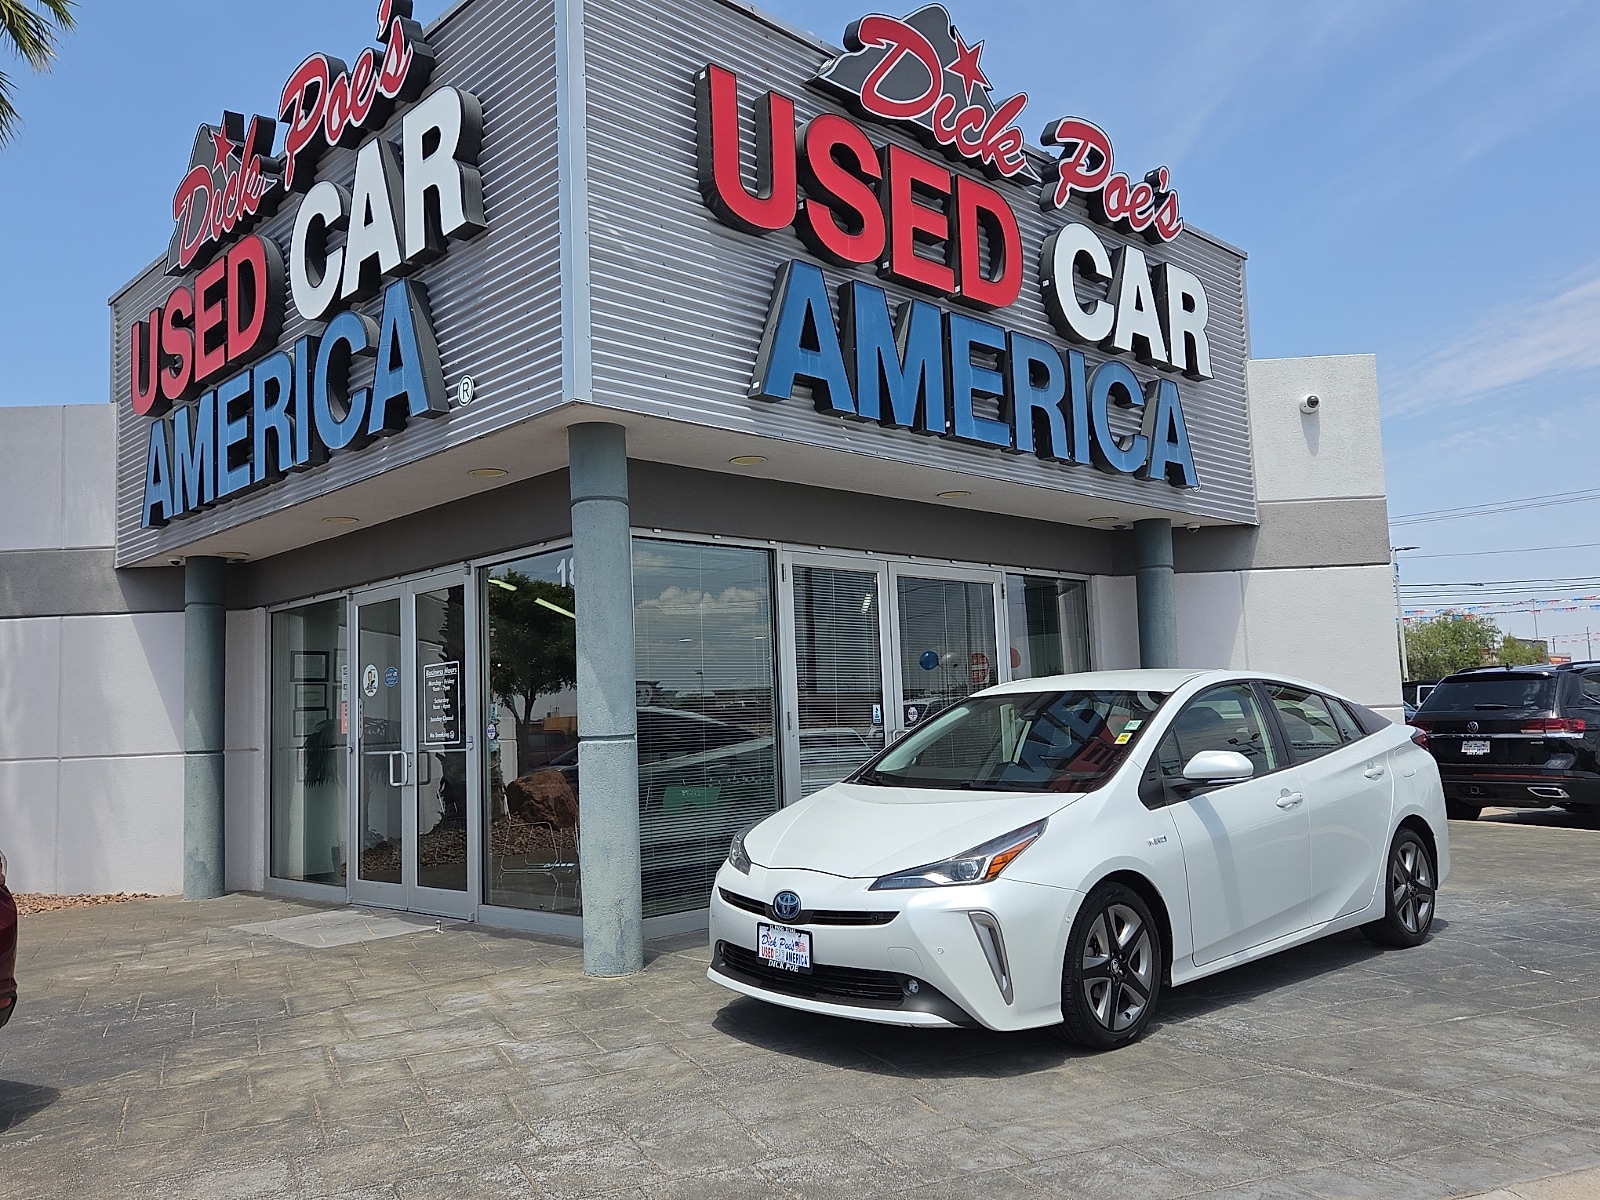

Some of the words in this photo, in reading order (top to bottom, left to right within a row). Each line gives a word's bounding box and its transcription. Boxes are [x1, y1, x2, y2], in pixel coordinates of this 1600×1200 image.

[173, 123, 268, 270] Dick
[279, 0, 414, 192] Poe's
[708, 63, 1023, 309] USED
[1053, 222, 1213, 380] CAR
[858, 15, 1028, 178] Dick
[1055, 117, 1184, 242] Poe's
[131, 234, 269, 417] USED
[290, 84, 465, 321] CAR
[140, 277, 429, 529] AMERICA
[761, 258, 1199, 489] AMERICA
[761, 933, 777, 948] Dick
[761, 945, 775, 959] USED
[785, 950, 807, 967] AMERICA
[768, 959, 785, 970] DICK
[785, 963, 799, 973] POE
